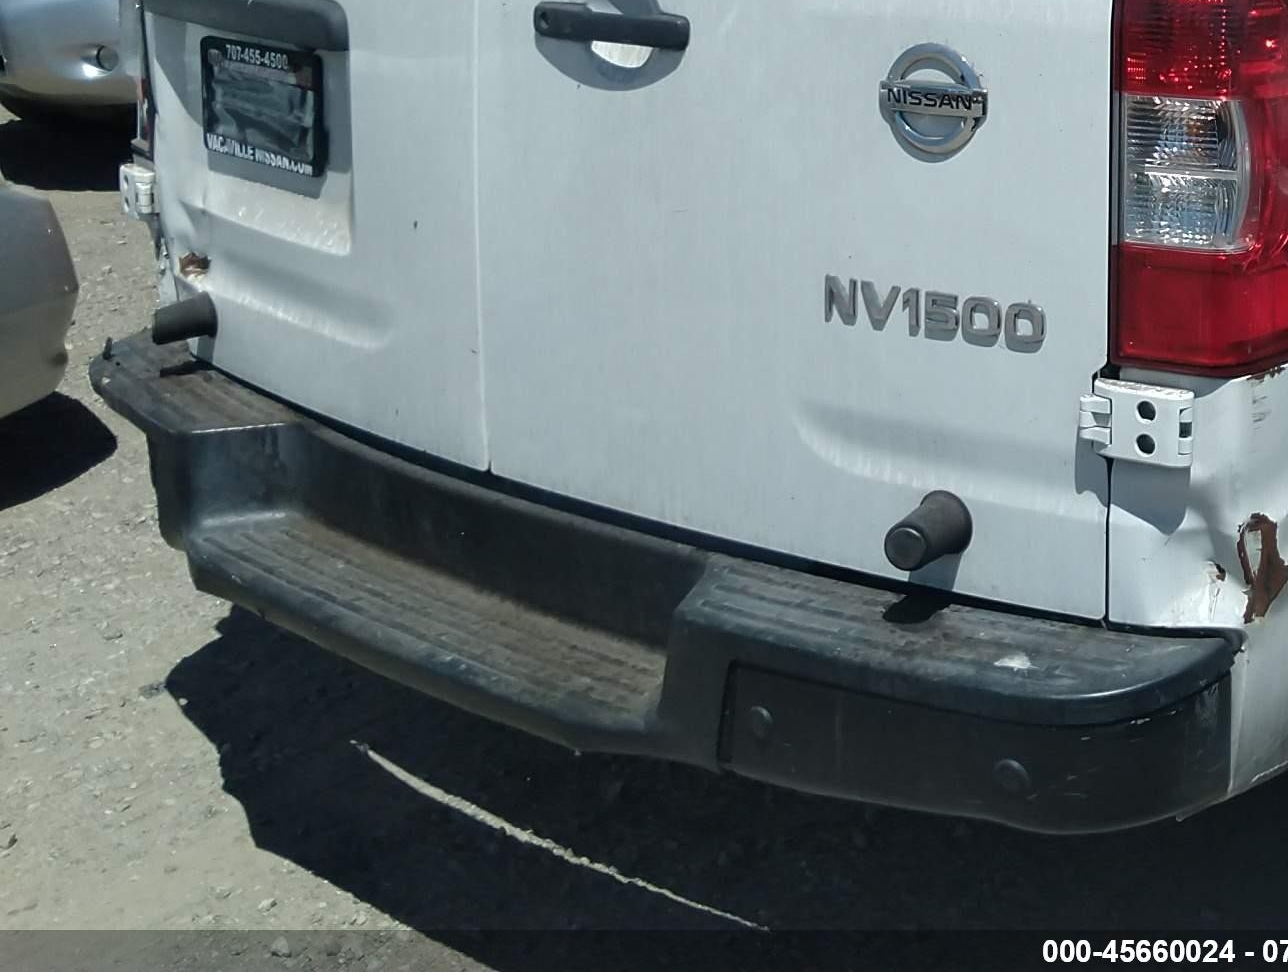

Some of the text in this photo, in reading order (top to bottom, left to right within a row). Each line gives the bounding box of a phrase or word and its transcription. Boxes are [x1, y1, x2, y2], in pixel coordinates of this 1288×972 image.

[225, 44, 289, 70] 707-455-4500
[887, 88, 973, 111] NISSAN
[206, 132, 254, 161] VACAVILLE
[824, 274, 1047, 354] NV1500
